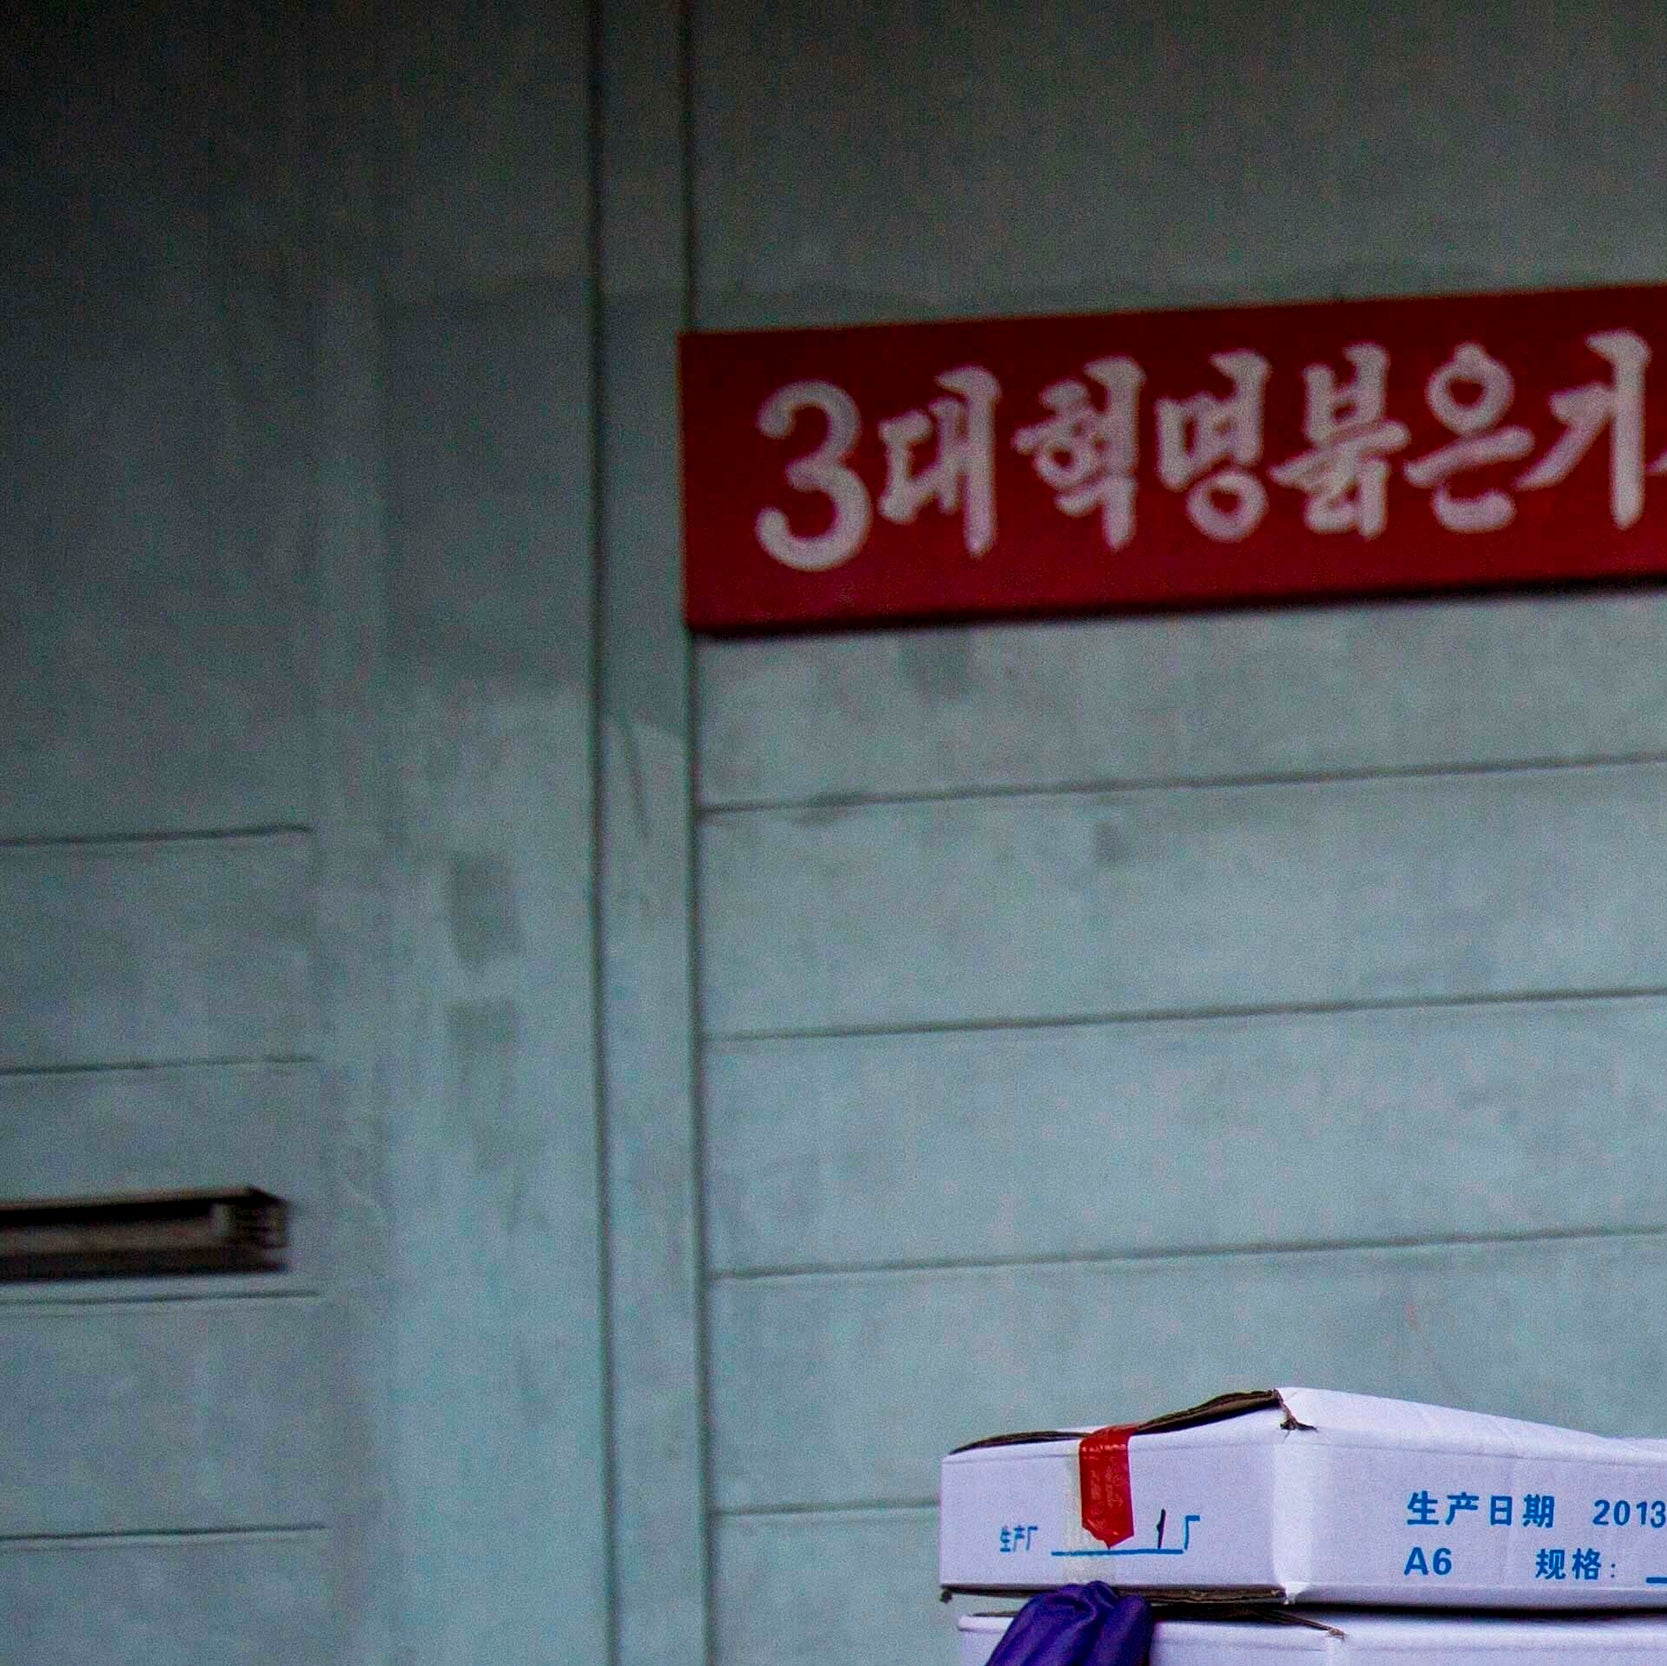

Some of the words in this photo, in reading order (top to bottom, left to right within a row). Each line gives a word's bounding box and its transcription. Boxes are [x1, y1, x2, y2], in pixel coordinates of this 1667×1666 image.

[1406, 1490, 1555, 1529] 生产日期
[1592, 1499, 1667, 1529] 2013
[999, 1525, 1039, 1554] 生产厂
[1184, 1515, 1200, 1550] 厂
[1403, 1546, 1453, 1576] A6
